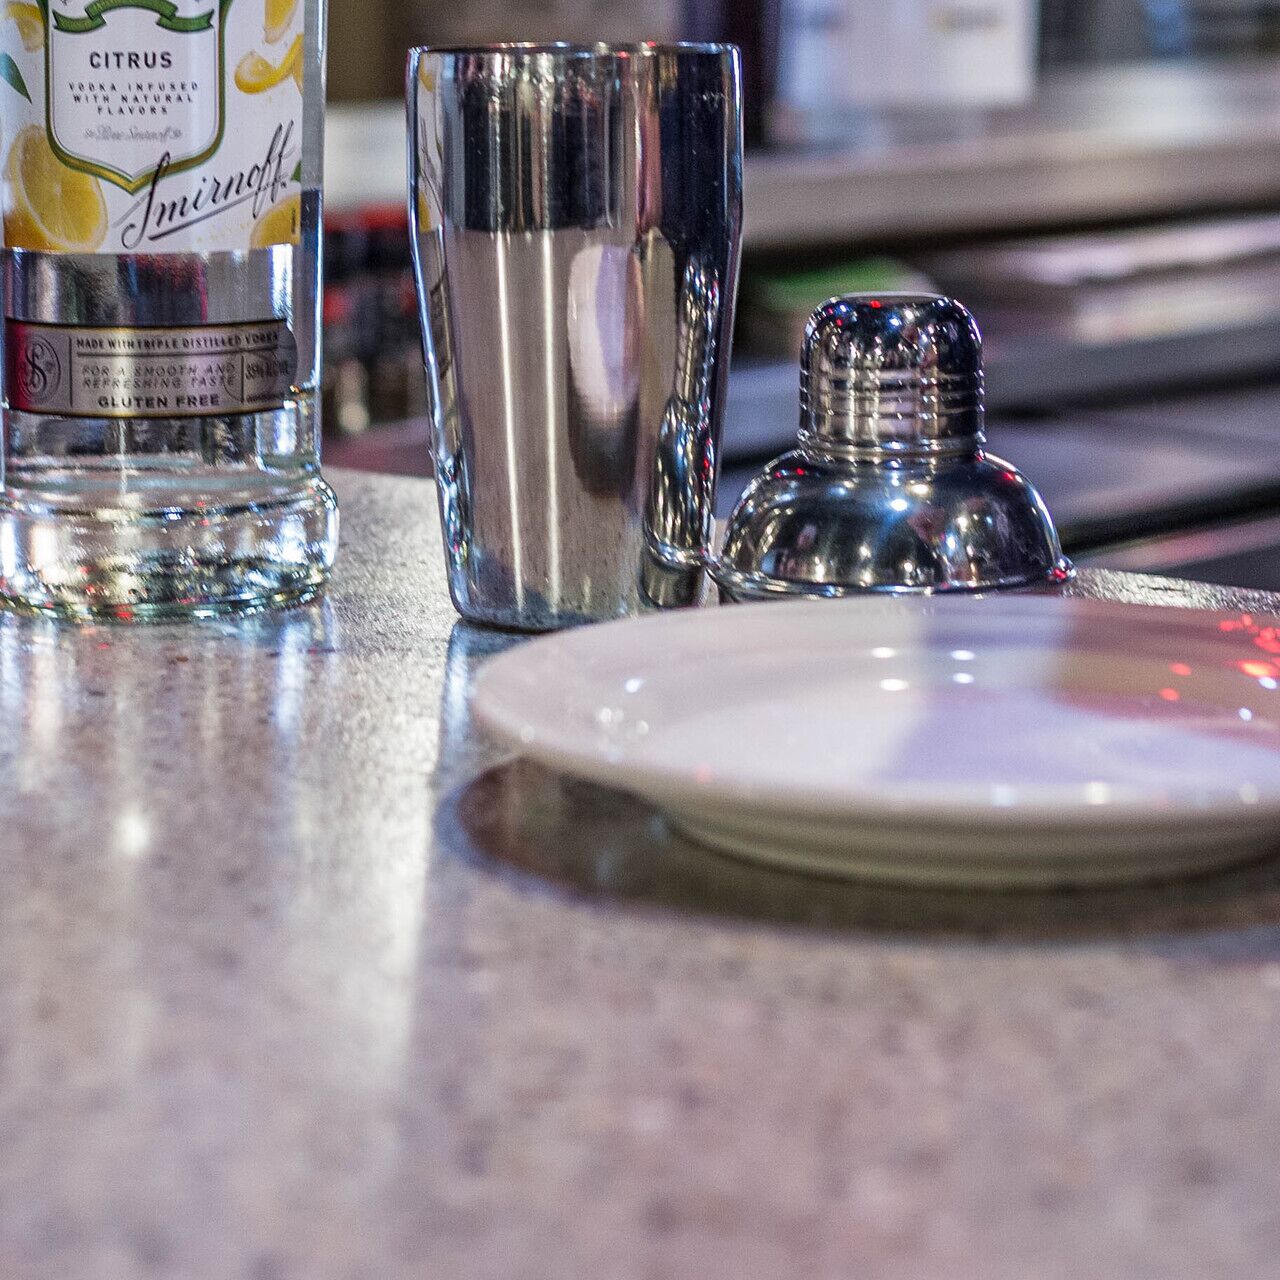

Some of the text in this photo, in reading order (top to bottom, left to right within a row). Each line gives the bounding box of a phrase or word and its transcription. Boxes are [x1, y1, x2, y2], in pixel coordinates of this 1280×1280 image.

[89, 51, 173, 70] CITRUS
[69, 81, 199, 92] VODKA INFUSED
[73, 93, 193, 104] WITH NATURAL
[97, 105, 168, 116] FLAVORS
[122, 120, 296, 249] Smirnoff
[76, 337, 104, 350] MADE
[97, 394, 220, 409] GLUTEN FREE
